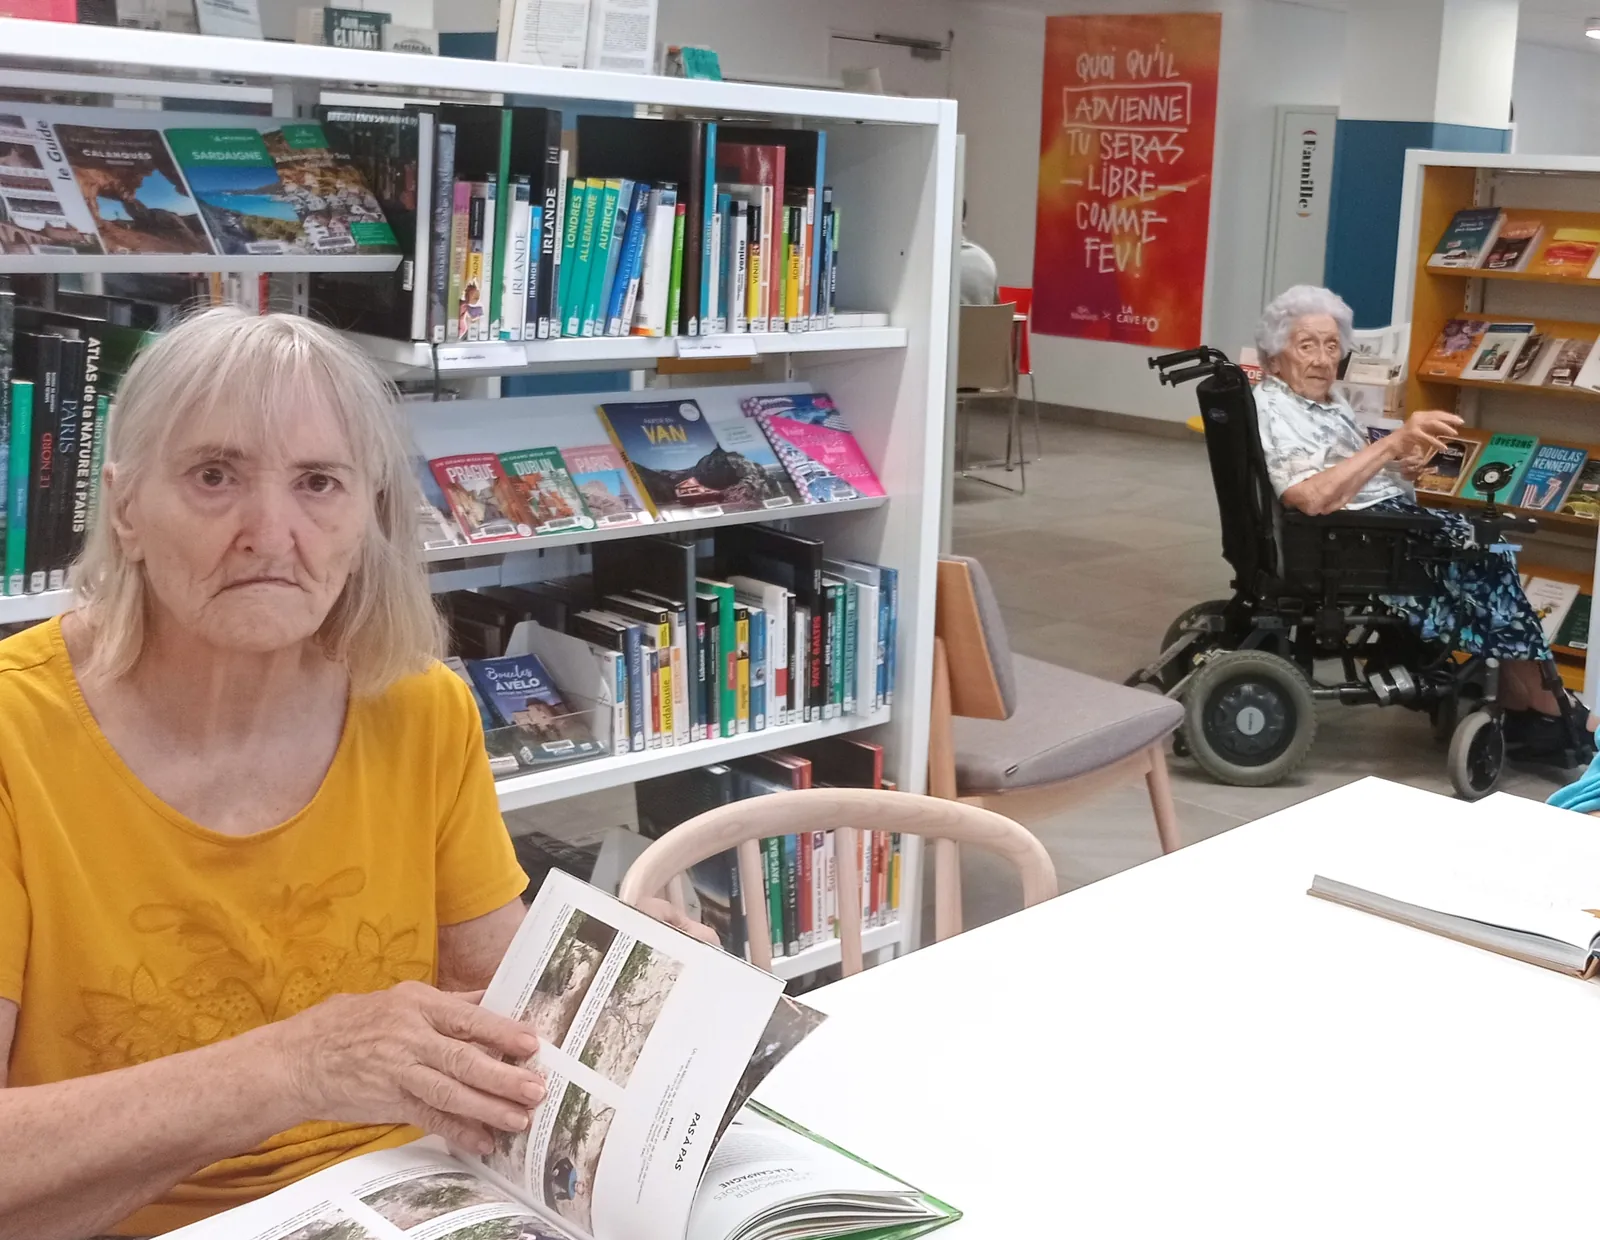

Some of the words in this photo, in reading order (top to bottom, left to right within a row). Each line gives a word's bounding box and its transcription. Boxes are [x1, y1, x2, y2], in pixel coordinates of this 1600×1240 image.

[333, 28, 378, 49] CLIMAT
[1076, 47, 1116, 82] QUOI
[1126, 38, 1179, 79] QU'IL
[1075, 94, 1184, 122] ADVIENNE
[35, 120, 64, 163] Guide
[82, 149, 152, 160] CALANQUES
[1068, 129, 1091, 156] TU
[1100, 131, 1184, 165] SERAS
[191, 151, 263, 161] SARDAIGNE
[57, 167, 73, 181] le
[1088, 161, 1156, 201] LIBRE
[1297, 139, 1317, 209] Famille
[543, 187, 557, 254] IRLANDE
[565, 195, 582, 248] LONDRES
[579, 193, 598, 263] ALLEMAGNE
[598, 194, 616, 250] AUTRICHE
[1076, 202, 1167, 243] COMME
[512, 233, 526, 295] IRLANDE
[752, 258, 760, 284] VENISE
[529, 262, 538, 298] IRLANDE
[1116, 314, 1140, 325] CAVE
[1121, 305, 1133, 315] LA
[84, 337, 101, 382] ATLAS
[82, 384, 97, 402] de
[59, 399, 79, 454] PARIS
[81, 406, 95, 419] la
[641, 424, 688, 444] VAN
[1491, 437, 1533, 449] LOVESONG
[41, 431, 53, 471] NORD
[76, 421, 93, 478] NATURE
[1539, 446, 1583, 462] DOUGLAS
[446, 463, 497, 483] PRAGUE
[513, 458, 555, 475] DUBLIN
[575, 456, 613, 474] PARIS
[1533, 457, 1578, 473] KENNEDY
[39, 476, 50, 489] LE
[75, 481, 88, 489] à
[72, 492, 87, 533] PARIS
[812, 616, 821, 655] BALTES
[484, 664, 532, 680] Boucles
[698, 649, 706, 682] Lisbonne
[811, 658, 820, 688] PAYS
[495, 679, 503, 691] À
[503, 677, 540, 691] VÉLO
[664, 679, 672, 730] andalousie
[770, 838, 779, 885] PAYS-BAS
[827, 857, 836, 892] Suisse
[688, 1112, 701, 1135] PAS
[682, 1136, 693, 1146] À
[674, 1147, 688, 1171] PAS
